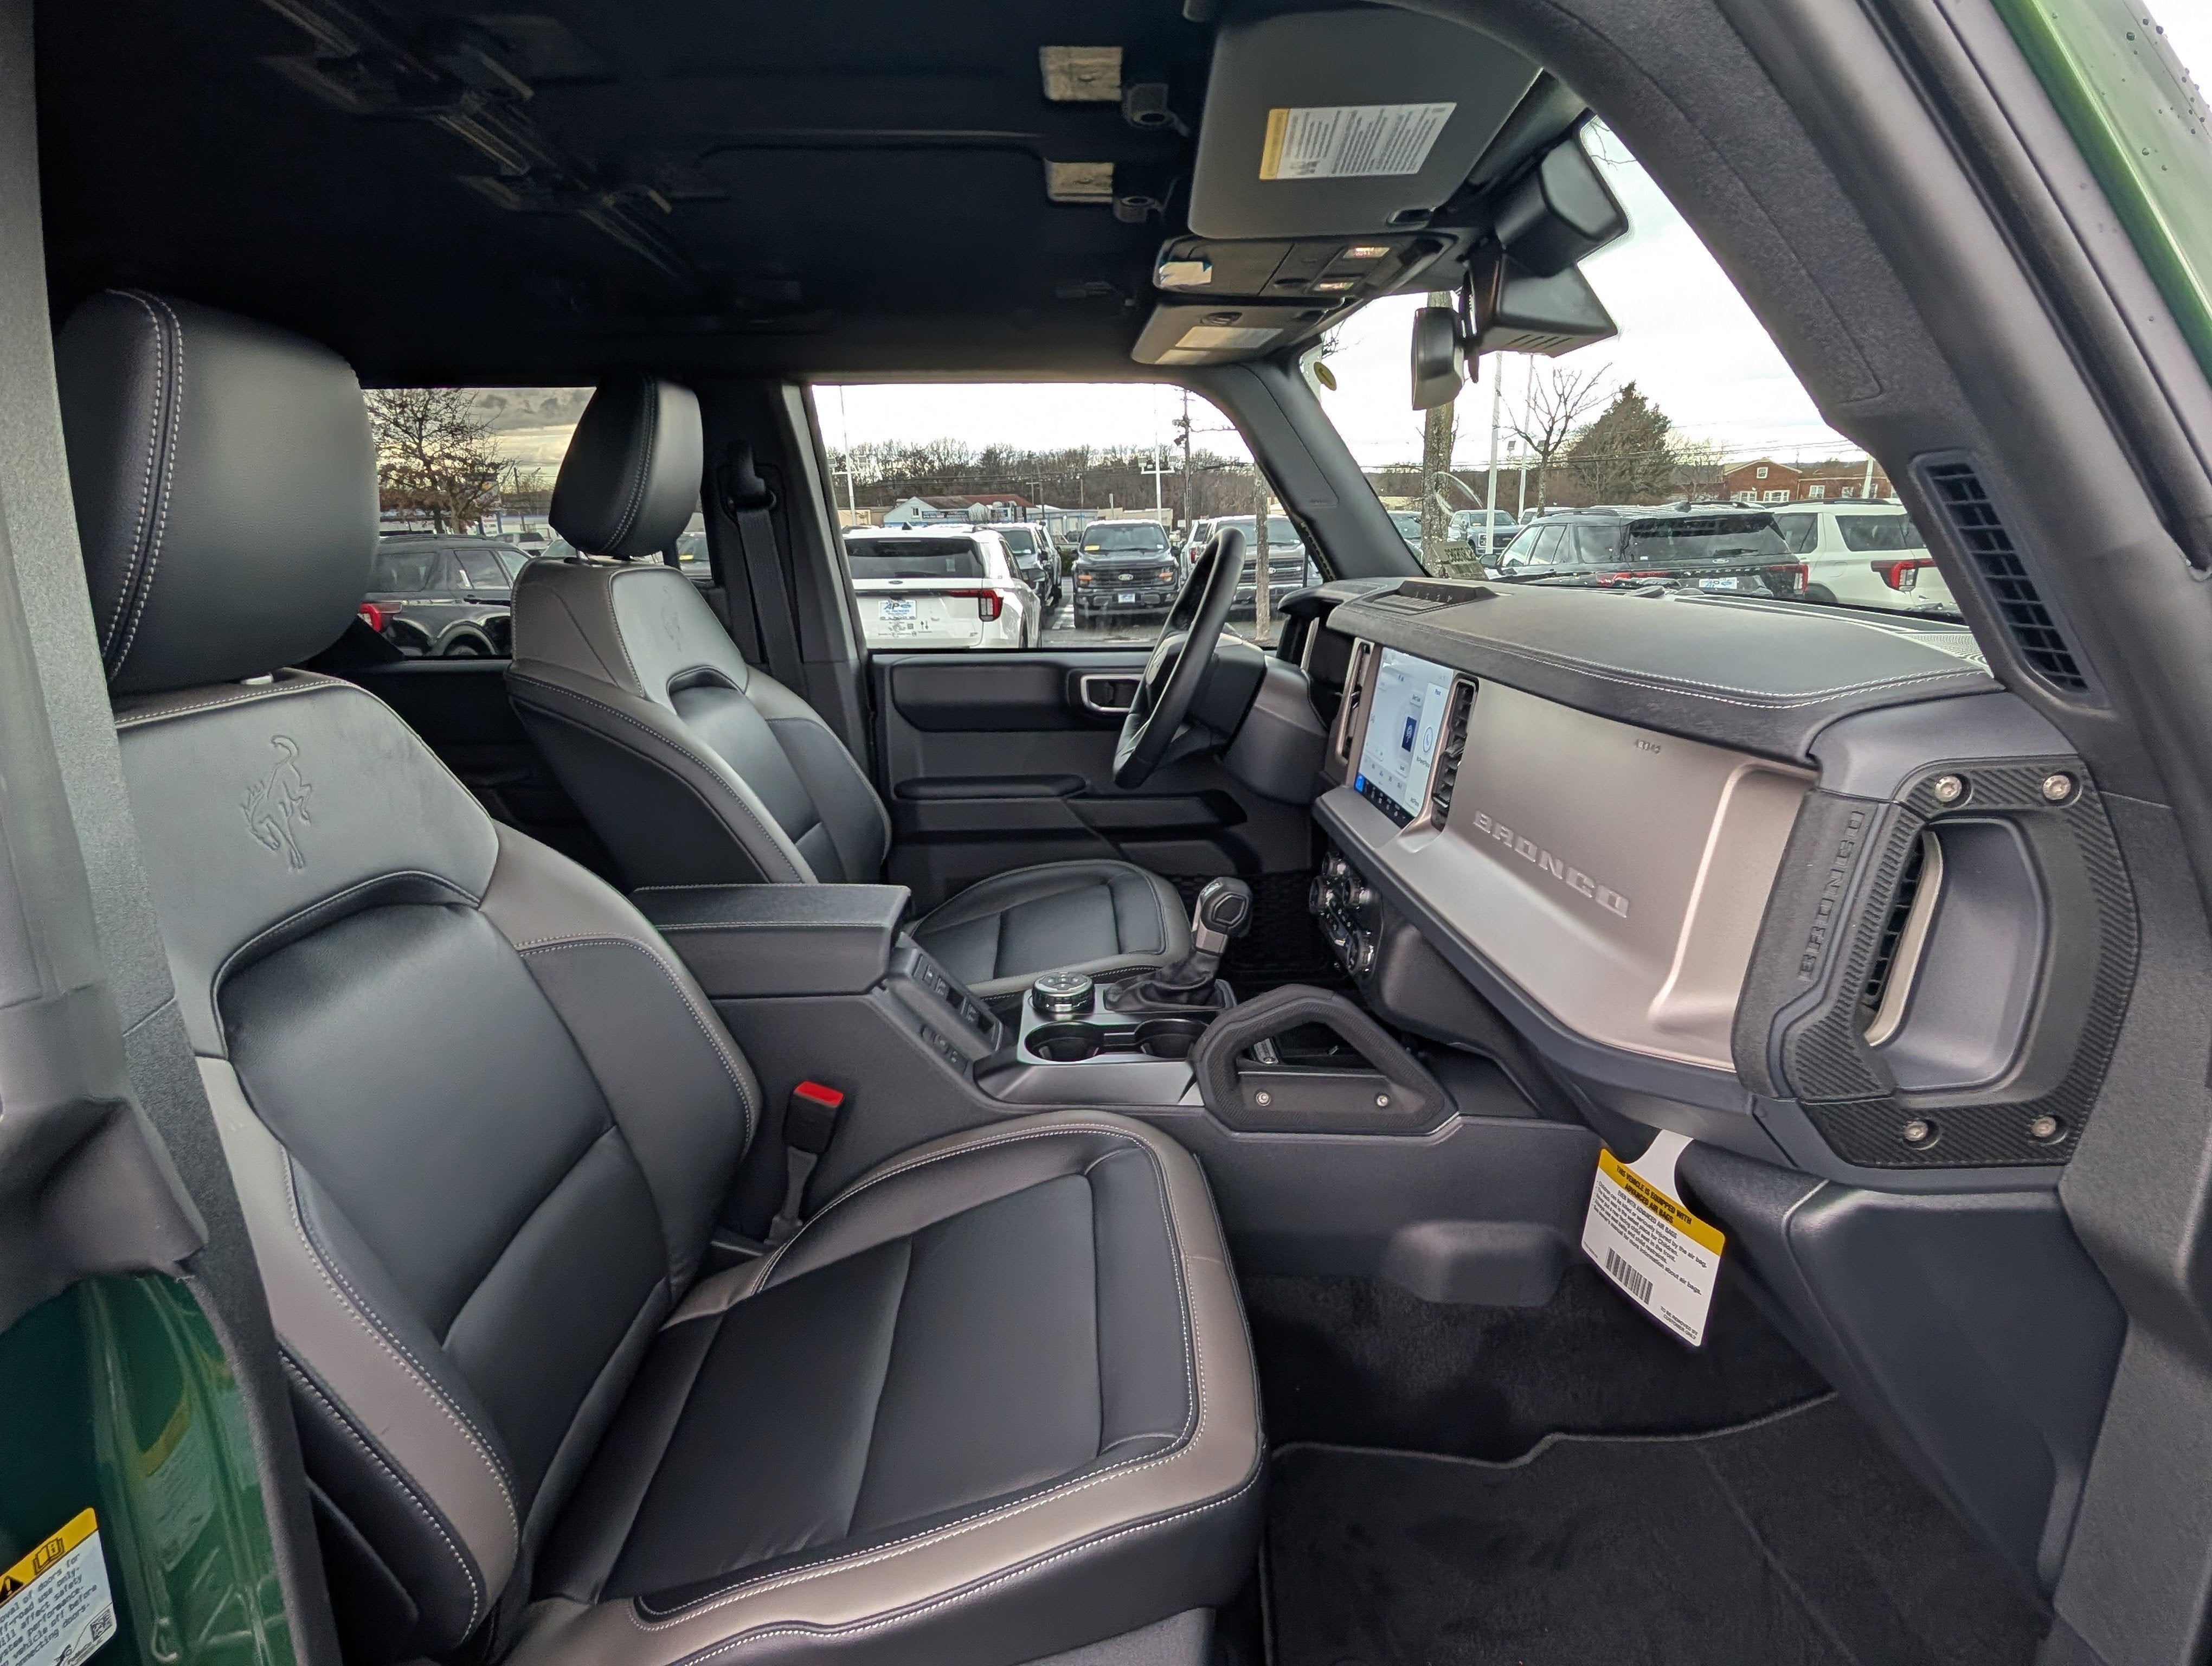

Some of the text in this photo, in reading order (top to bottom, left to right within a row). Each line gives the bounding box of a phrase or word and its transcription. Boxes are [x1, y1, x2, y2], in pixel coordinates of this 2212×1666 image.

[1472, 811, 1629, 918] BRONCO
[1798, 810, 1865, 981] BRONCO
[1616, 1165, 1625, 1176] THIS
[1626, 1174, 1644, 1191] VEHICLE
[1650, 1191, 1675, 1214] EQUIPPED
[1676, 1209, 1692, 1224] WITH
[1625, 1182, 1674, 1223] ADVANCED AIR BAGS
[21, 1601, 50, 1630] affect
[54, 1574, 82, 1601] safety
[38, 1568, 62, 1592] doors
[67, 1553, 80, 1568] for
[12, 1627, 48, 1658] vehicle
[69, 1584, 97, 1611] before
